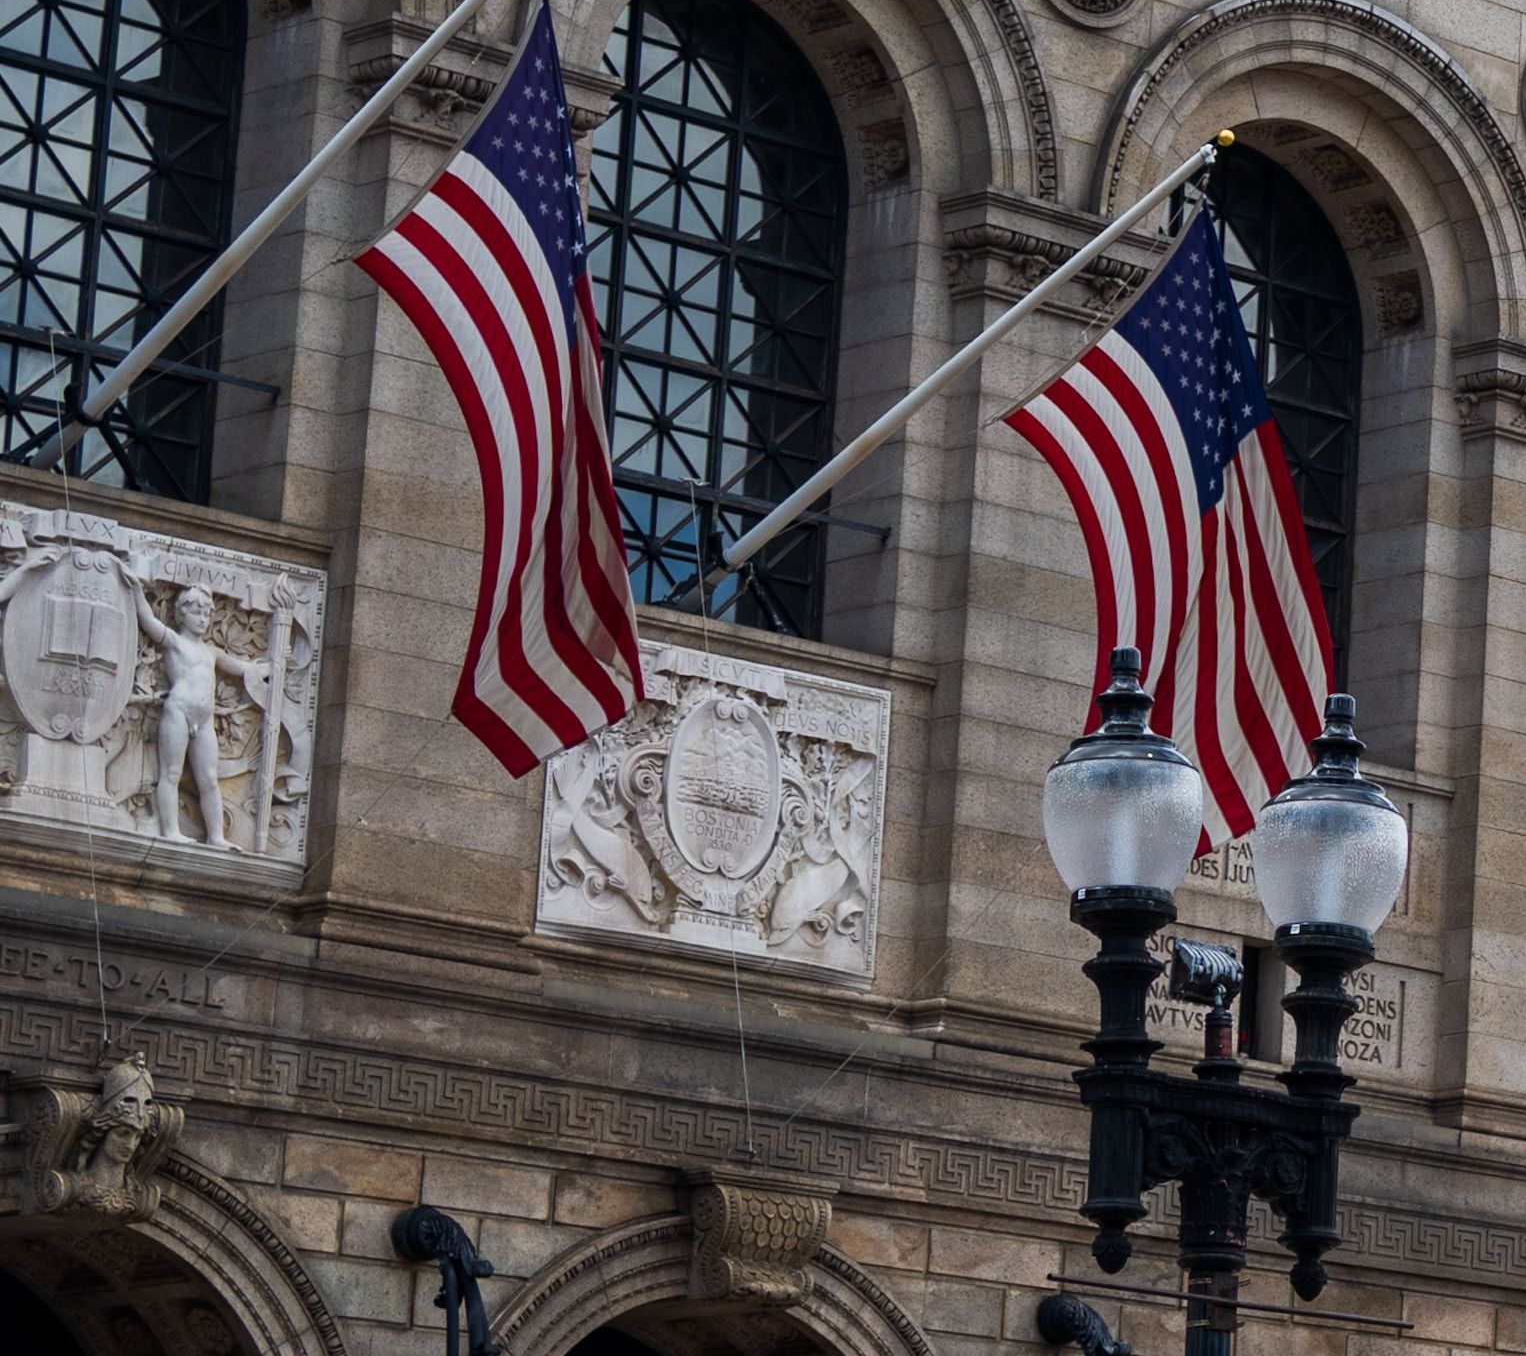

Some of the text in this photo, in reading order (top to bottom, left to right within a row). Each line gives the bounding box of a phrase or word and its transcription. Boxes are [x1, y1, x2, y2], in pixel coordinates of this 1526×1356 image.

[65, 513, 114, 538] LVX
[163, 555, 237, 590] CIVIVM
[775, 711, 871, 744] DEVS NOBIS
[684, 807, 758, 836] BOSTONIA
[685, 823, 739, 843] CONDITA
[68, 955, 225, 1010] TO ALL
